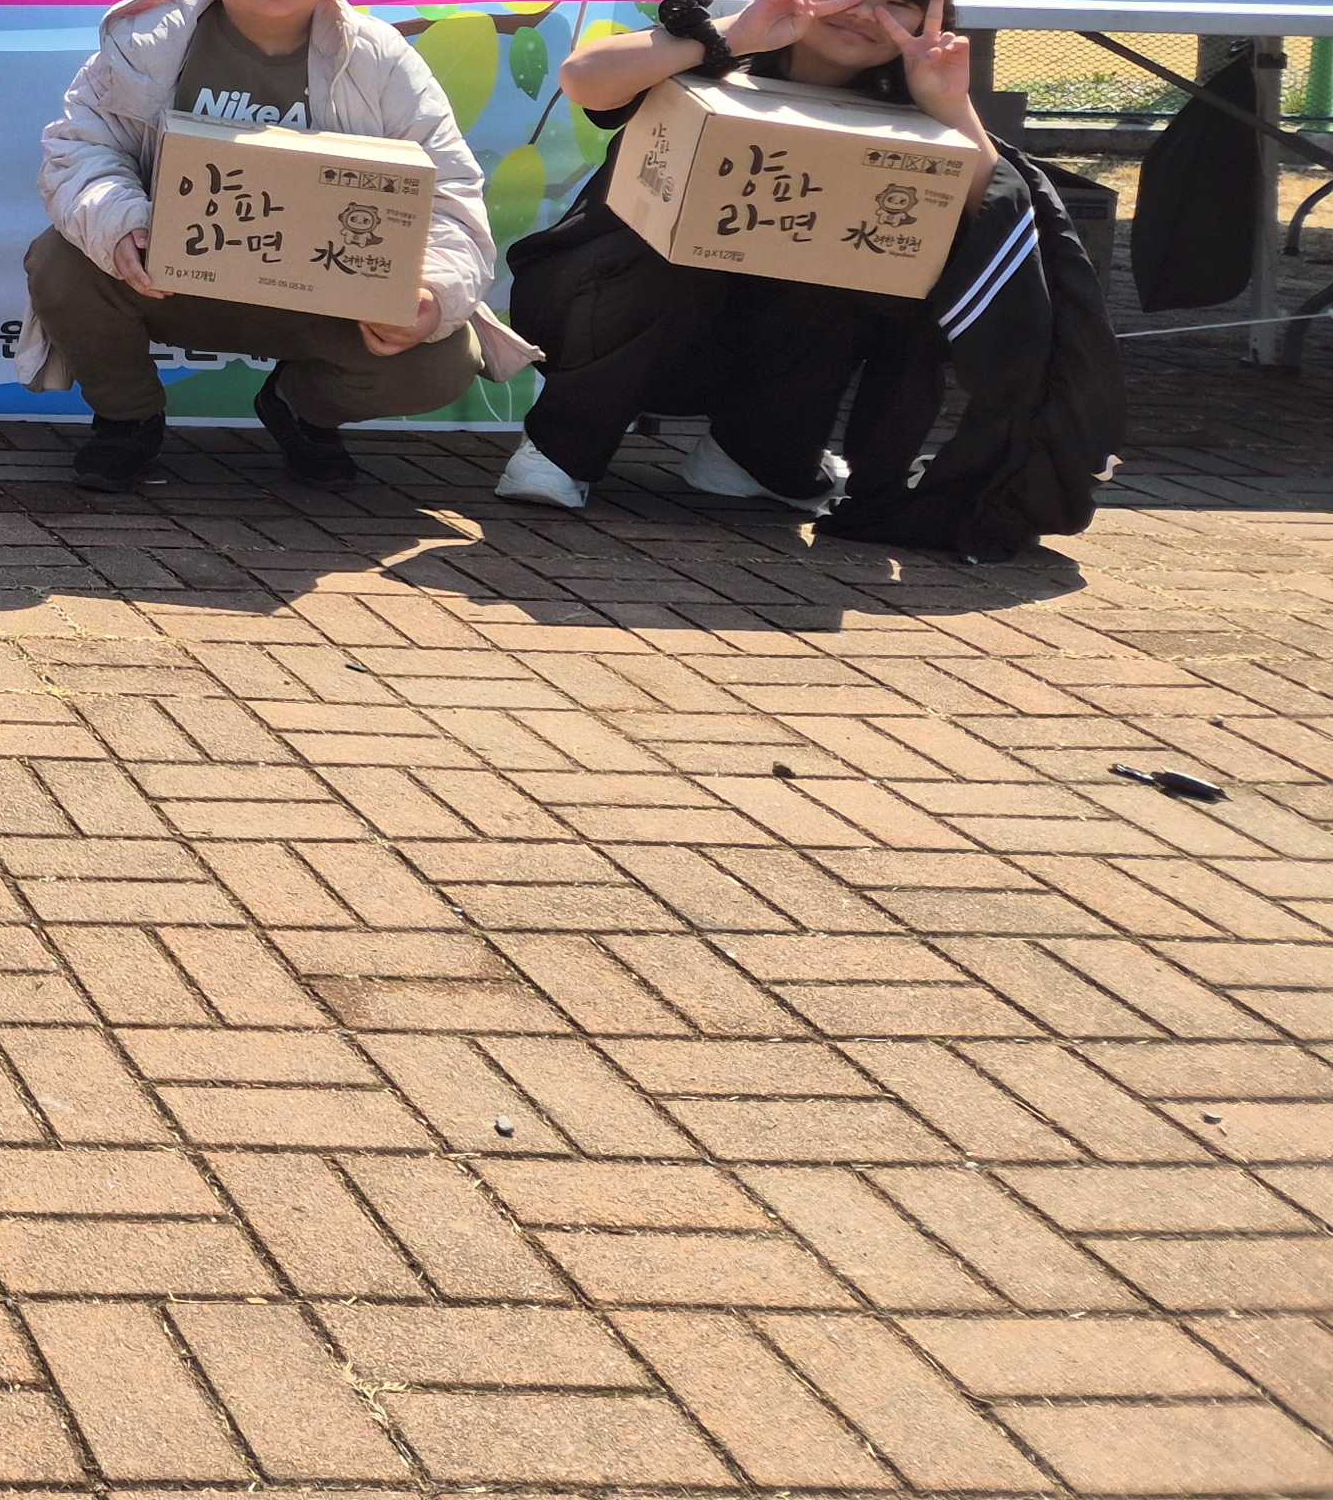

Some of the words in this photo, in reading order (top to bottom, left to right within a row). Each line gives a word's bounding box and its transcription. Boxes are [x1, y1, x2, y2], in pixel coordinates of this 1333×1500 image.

[179, 163, 285, 222] 양파
[718, 144, 823, 202] 양파
[185, 224, 283, 263] 라면
[717, 203, 817, 242] 라면
